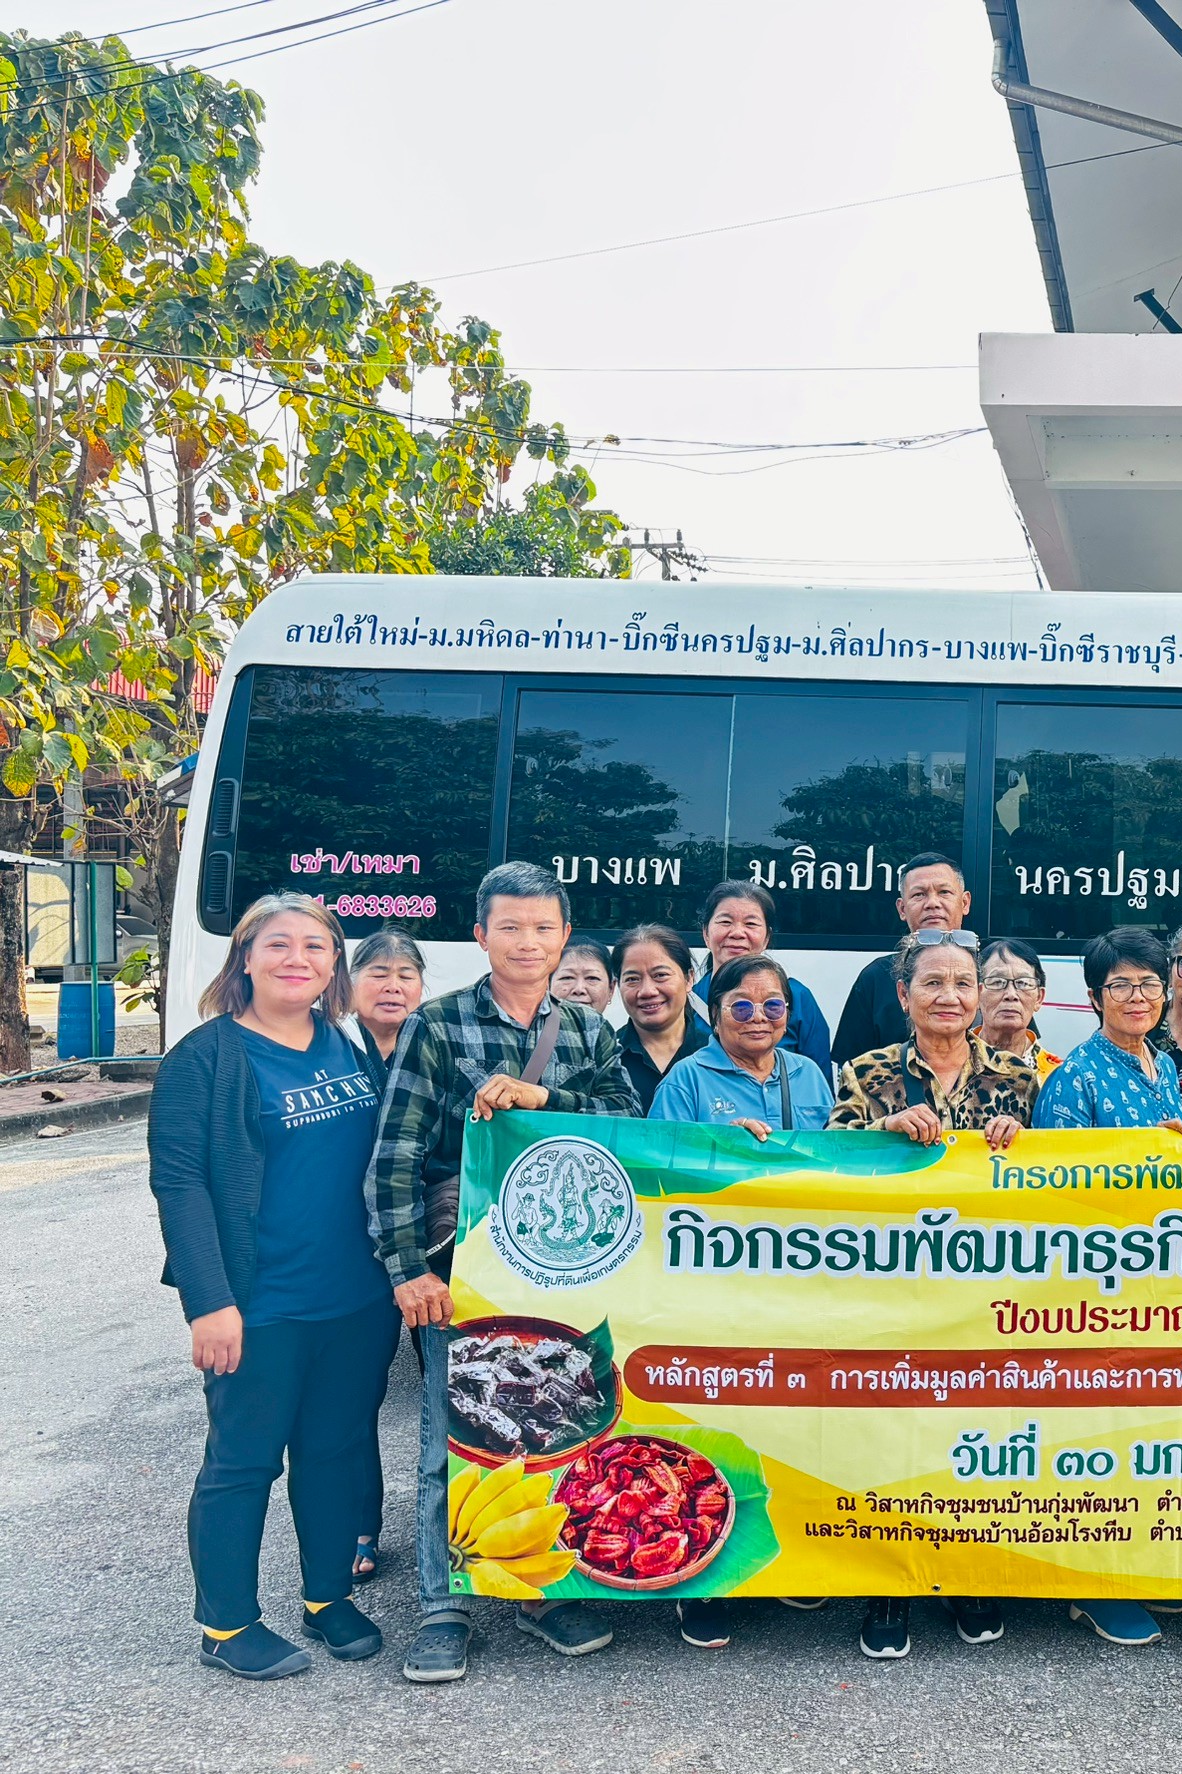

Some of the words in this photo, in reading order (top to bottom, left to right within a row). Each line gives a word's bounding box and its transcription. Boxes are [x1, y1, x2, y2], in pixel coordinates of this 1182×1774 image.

[290, 848, 421, 874] เช่า/เหมา
[552, 855, 681, 886] บางแพ
[1015, 850, 1180, 910] นครปฐม
[314, 1069, 328, 1082] AT
[645, 1353, 774, 1399] หลักสูตรที่
[787, 1373, 806, 1389] ๓
[952, 1423, 1036, 1476] วันที่
[1056, 1451, 1114, 1476] ๓๐
[836, 1496, 857, 1511] ณ
[865, 1491, 1139, 1522] วิสาหกิจชุมชนบ้านกุ่มพัฒนา
